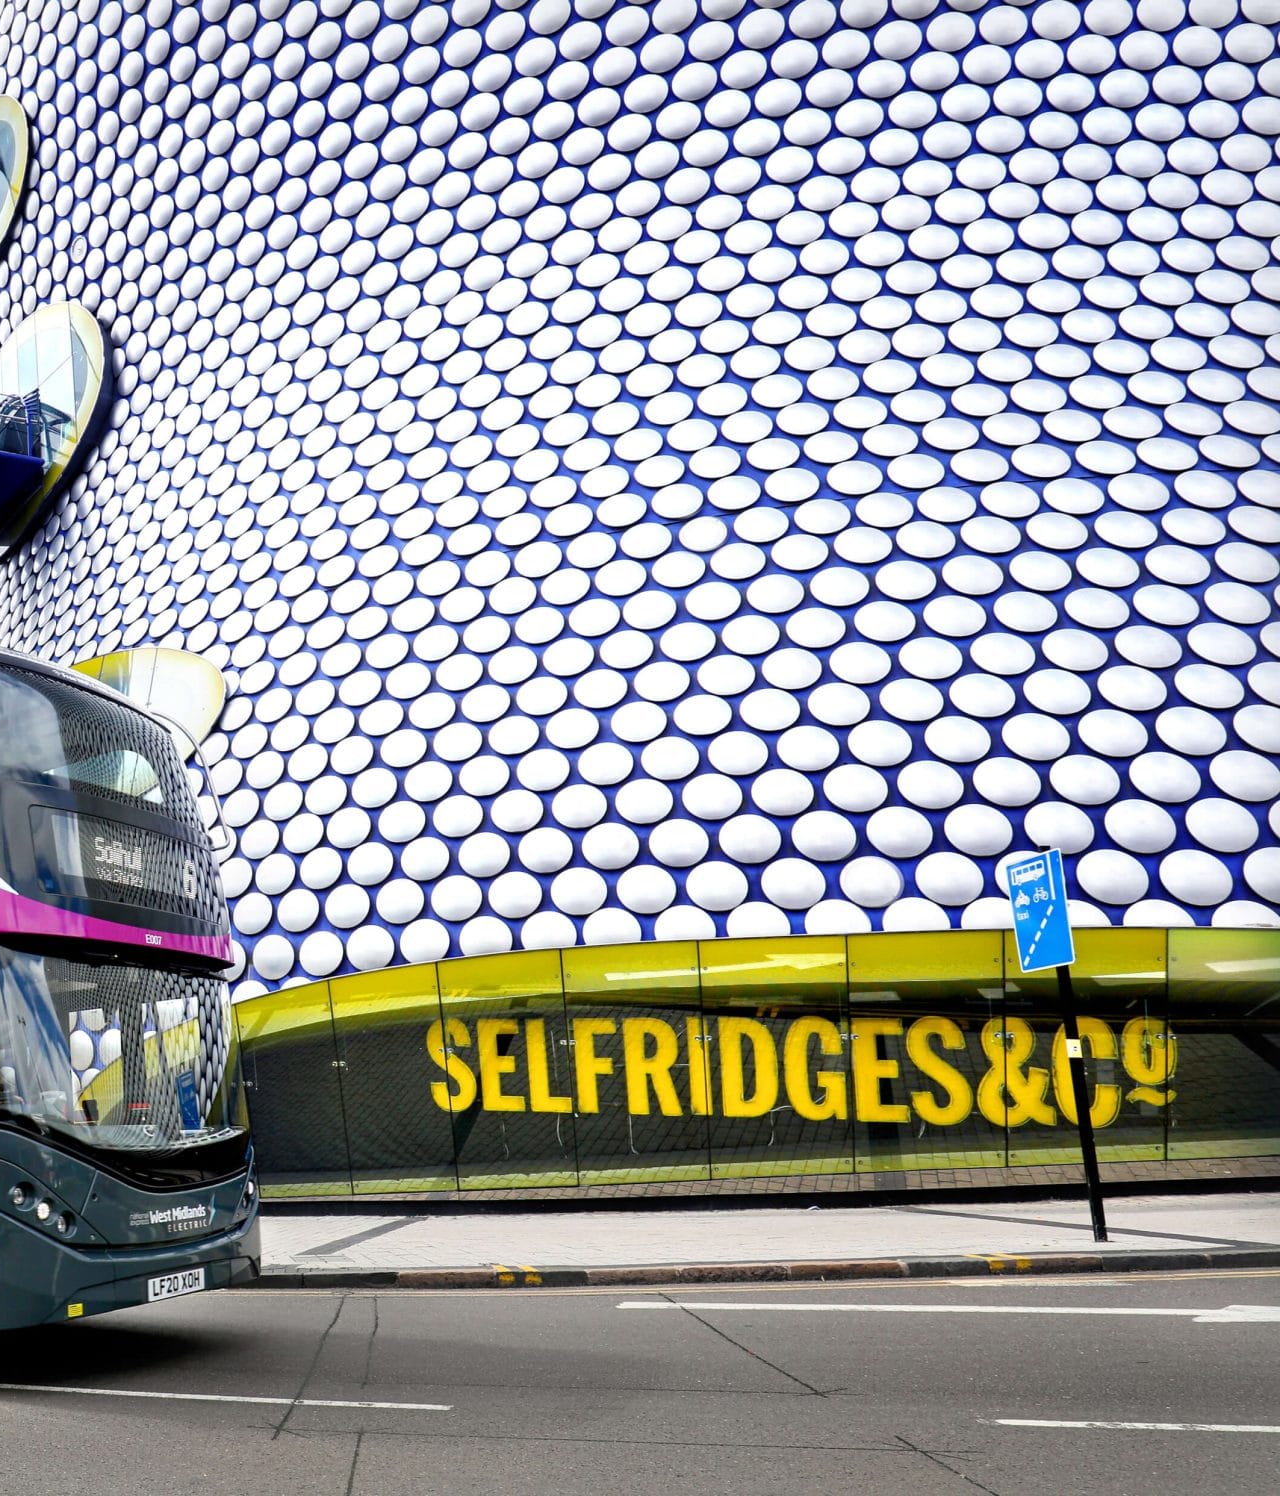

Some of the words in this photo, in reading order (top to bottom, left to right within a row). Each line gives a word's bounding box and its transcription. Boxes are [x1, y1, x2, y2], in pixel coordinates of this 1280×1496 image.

[94, 836, 142, 871] Solihull
[145, 934, 163, 945] E007
[149, 1209, 172, 1224] West
[171, 1203, 206, 1221] Midlands
[167, 1218, 208, 1233] ELECTRIC
[152, 1276, 179, 1297] LF20
[181, 1270, 201, 1290] XOH
